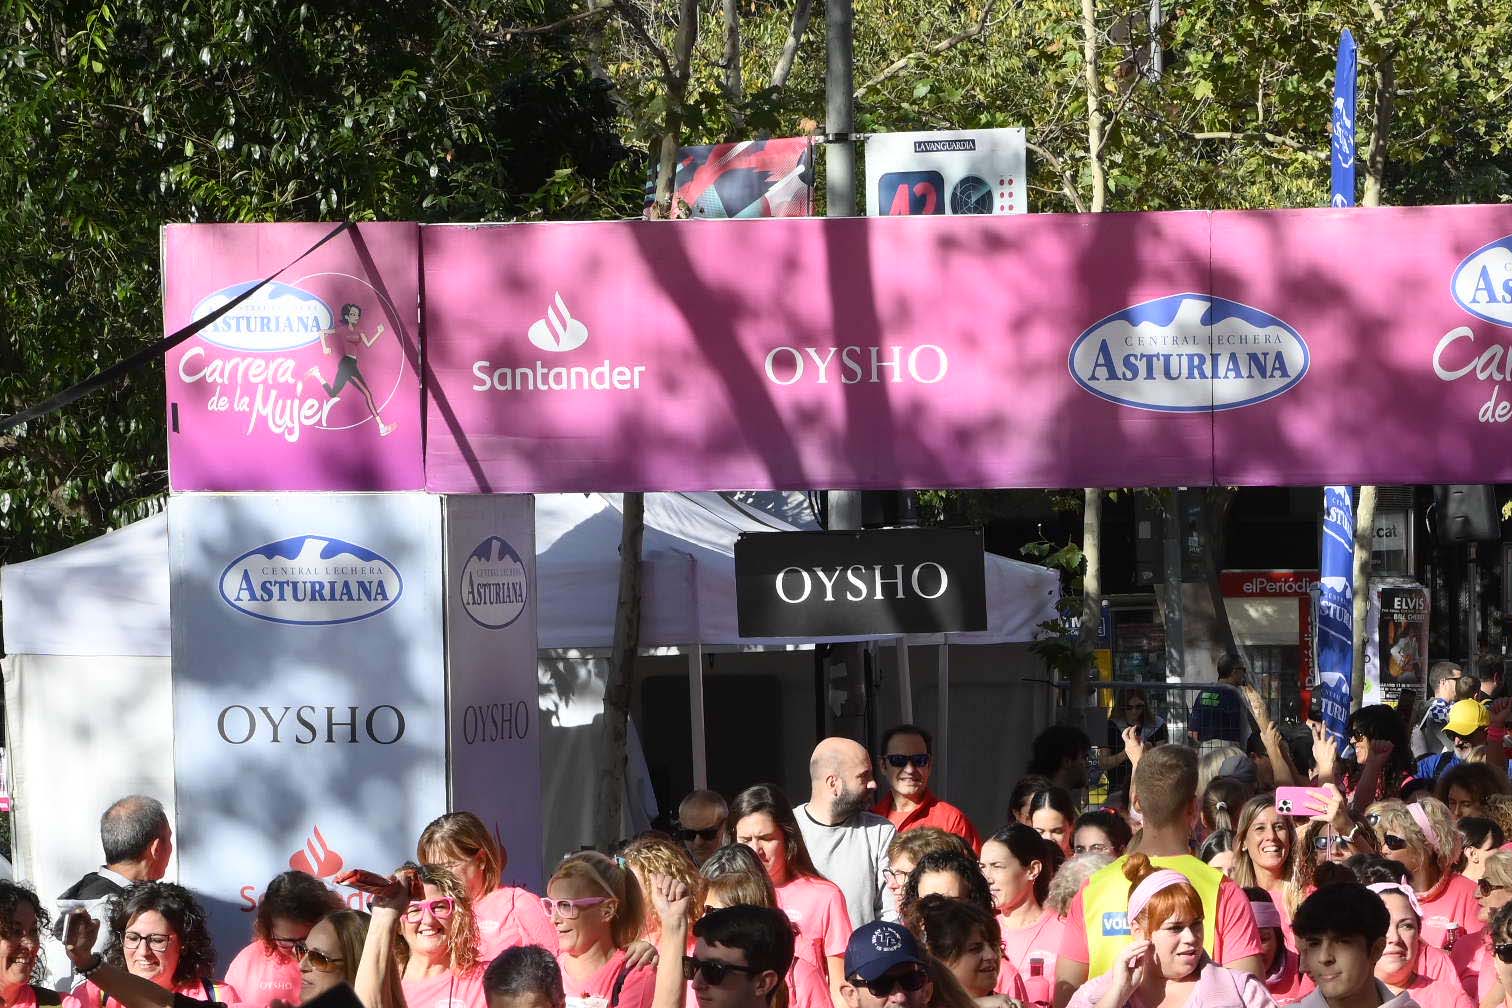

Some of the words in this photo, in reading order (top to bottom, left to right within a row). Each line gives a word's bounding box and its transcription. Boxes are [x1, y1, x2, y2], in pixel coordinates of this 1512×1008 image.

[1124, 334, 1200, 346] CENTRAL
[1208, 333, 1284, 345] LECHERA
[178, 346, 297, 384] Carrera
[472, 360, 646, 392] Santander
[764, 344, 949, 385] OYSHO
[1087, 338, 1292, 382] ASTURIANA
[207, 388, 230, 412] de
[233, 386, 250, 412] la
[247, 381, 341, 442] Mujer
[1479, 390, 1512, 424] de
[234, 568, 389, 602] ASTURIANA
[262, 566, 320, 576] CENTRAL
[325, 566, 384, 576] LECHERA
[465, 570, 524, 606] ASTURIANA
[775, 561, 949, 603] OYSHO
[1394, 597, 1425, 610] ELVIS
[217, 704, 406, 745] OYSHO
[463, 700, 529, 745] OYSHO
